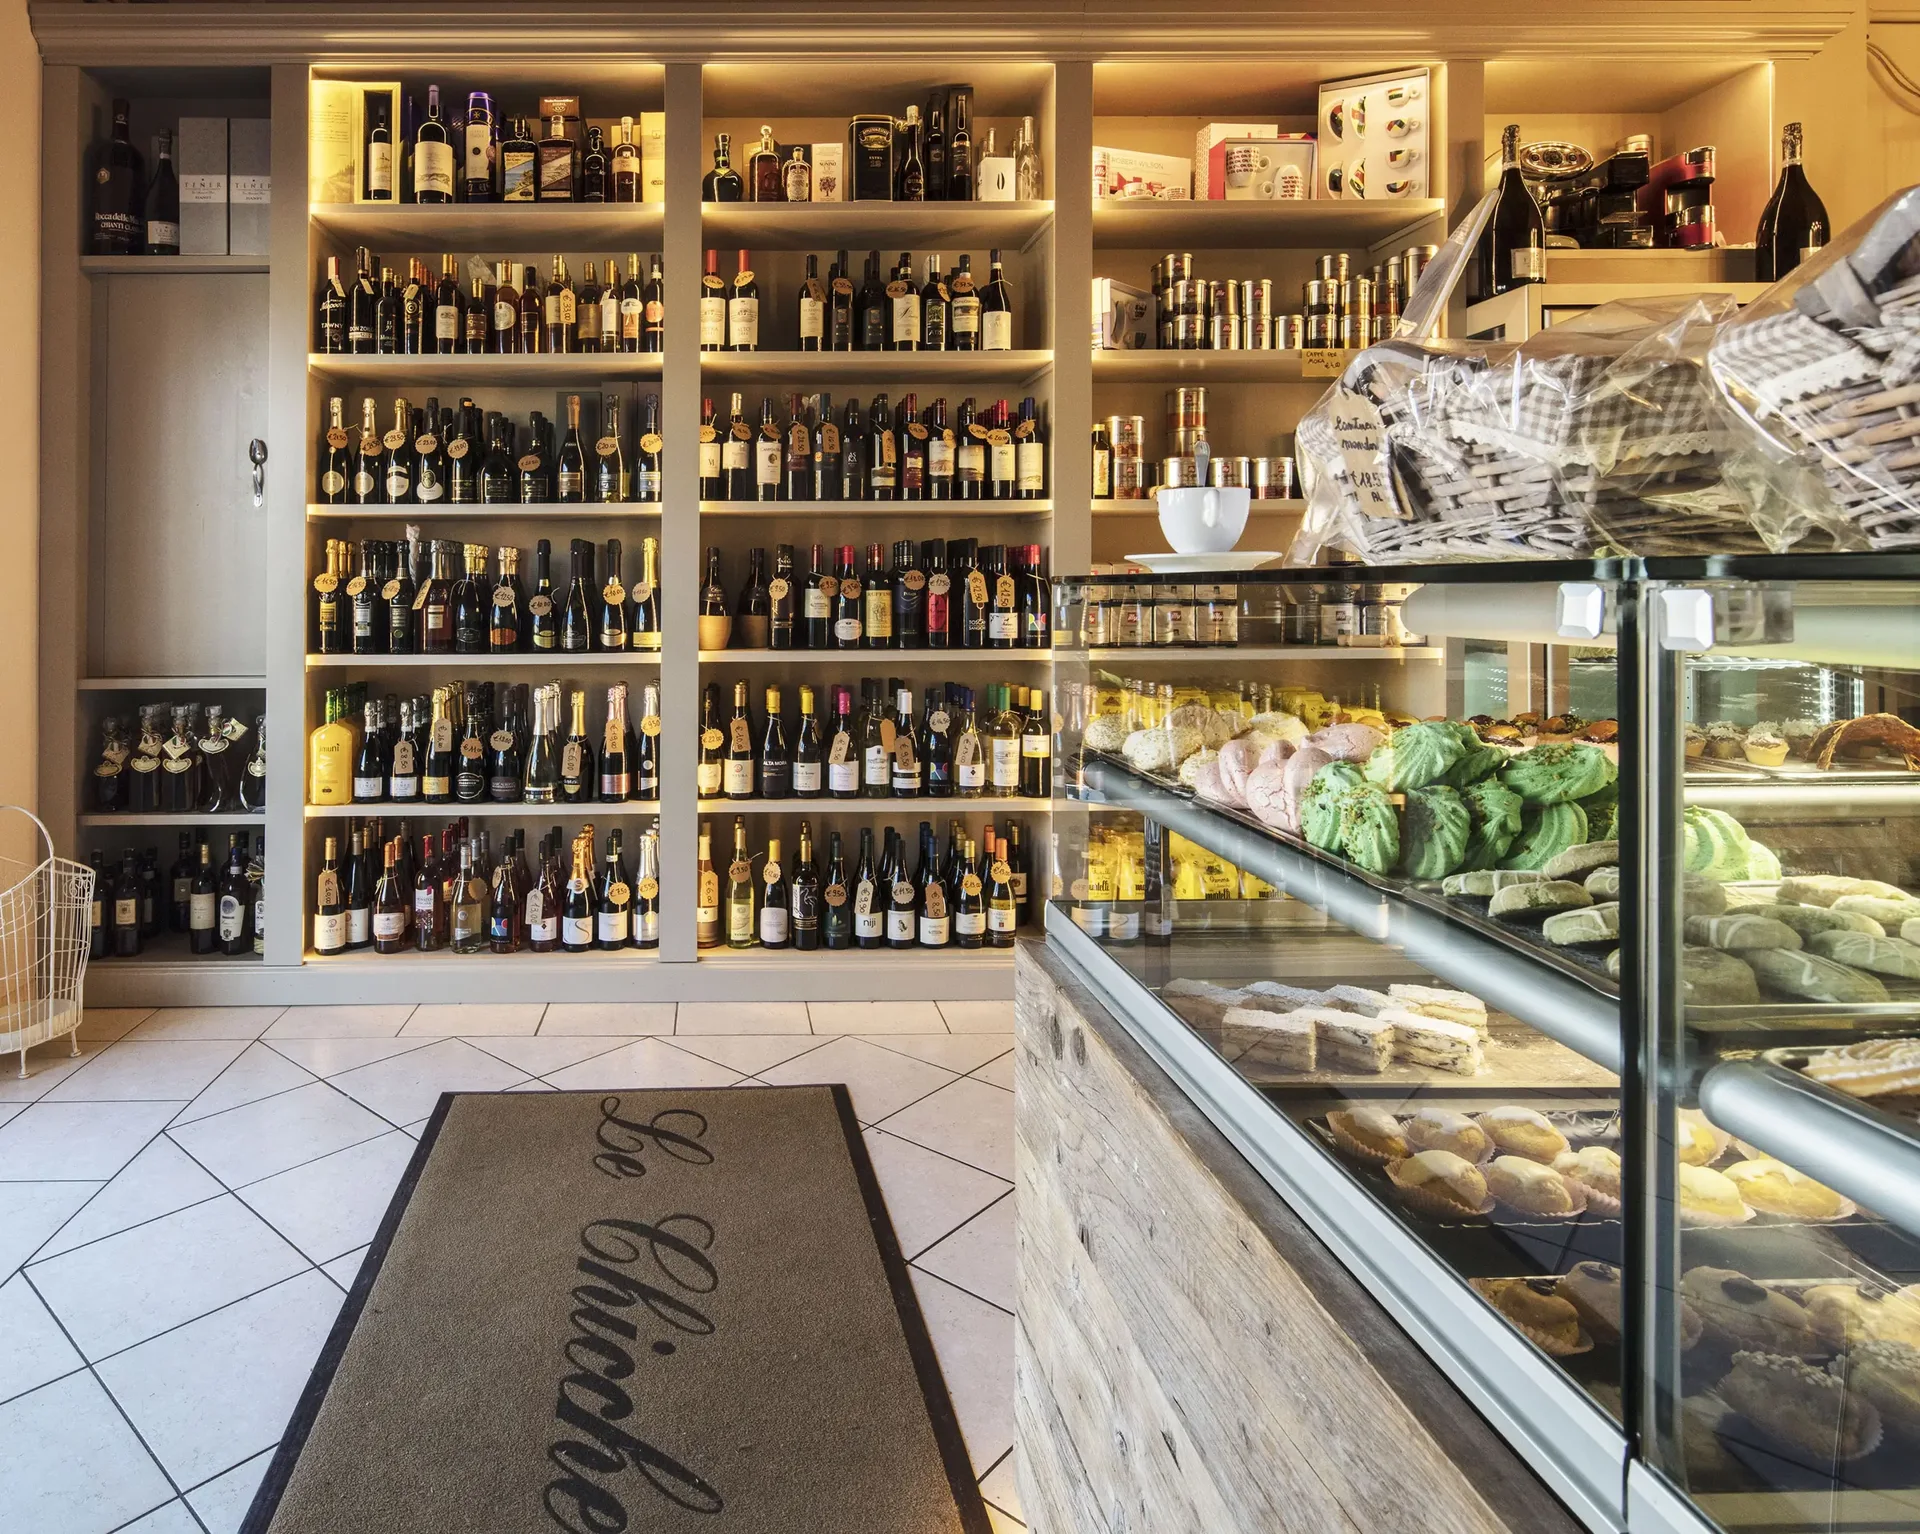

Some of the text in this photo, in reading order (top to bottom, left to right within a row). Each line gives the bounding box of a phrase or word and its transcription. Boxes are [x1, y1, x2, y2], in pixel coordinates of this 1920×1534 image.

[1112, 157, 1164, 170] ROBERT WILSON
[1001, 581, 1011, 606] €12.50
[863, 918, 876, 928] niji
[544, 1096, 724, 1534] Le Chicche
